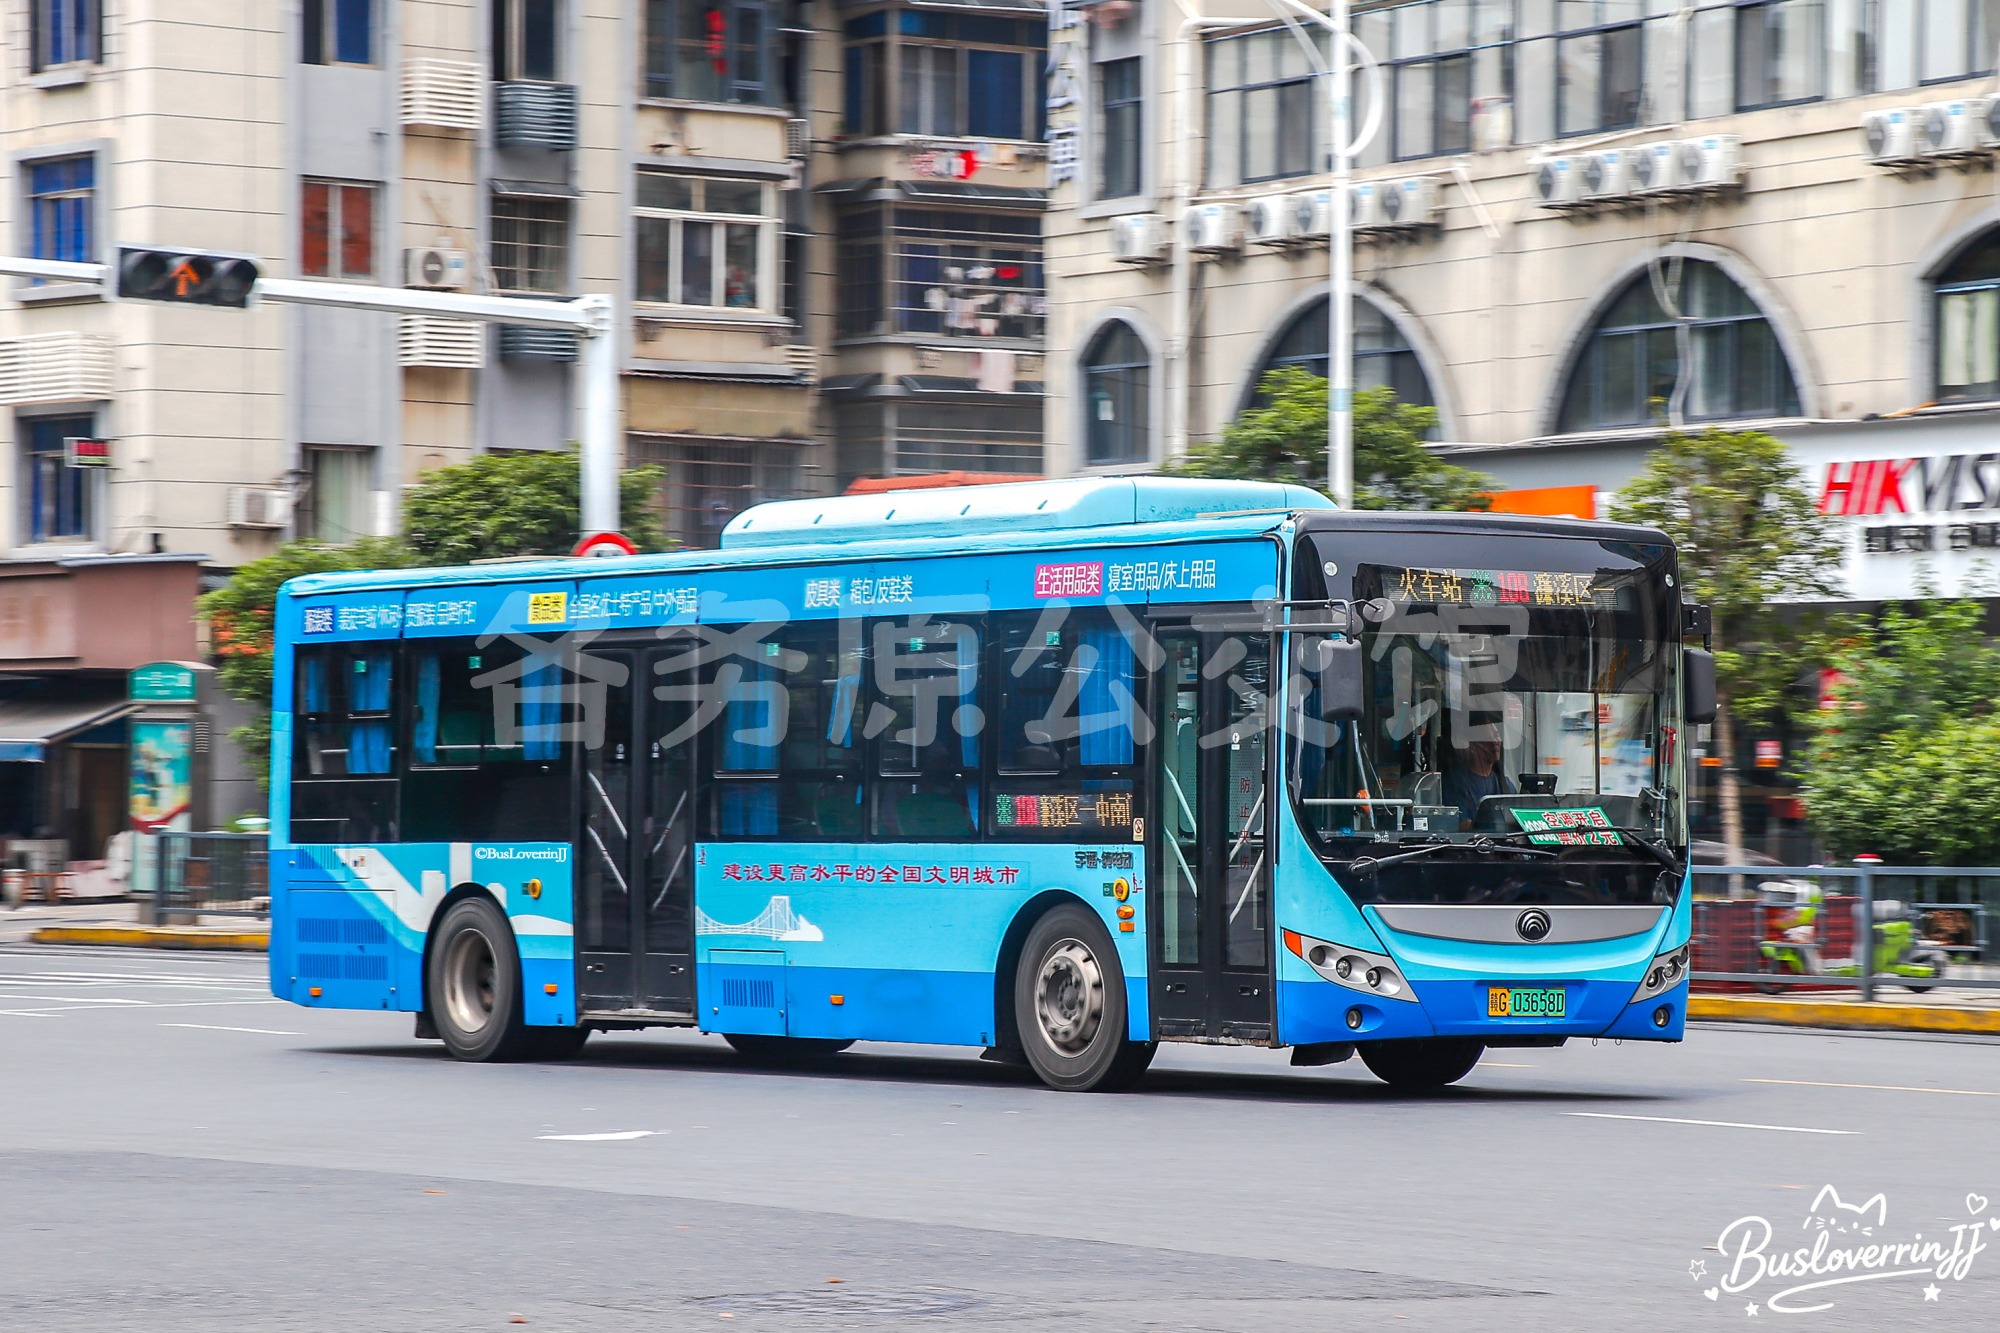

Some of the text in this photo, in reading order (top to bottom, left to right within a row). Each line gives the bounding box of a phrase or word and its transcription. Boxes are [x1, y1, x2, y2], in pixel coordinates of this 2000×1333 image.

[1036, 559, 1217, 596] 生活用品类 寝室用品/床上用品
[1400, 566, 1464, 604] 火车站
[804, 579, 841, 608] 皮具类
[1542, 810, 1609, 829] 空调开启
[721, 862, 1020, 885] 建设更高水平的全国文明城市
